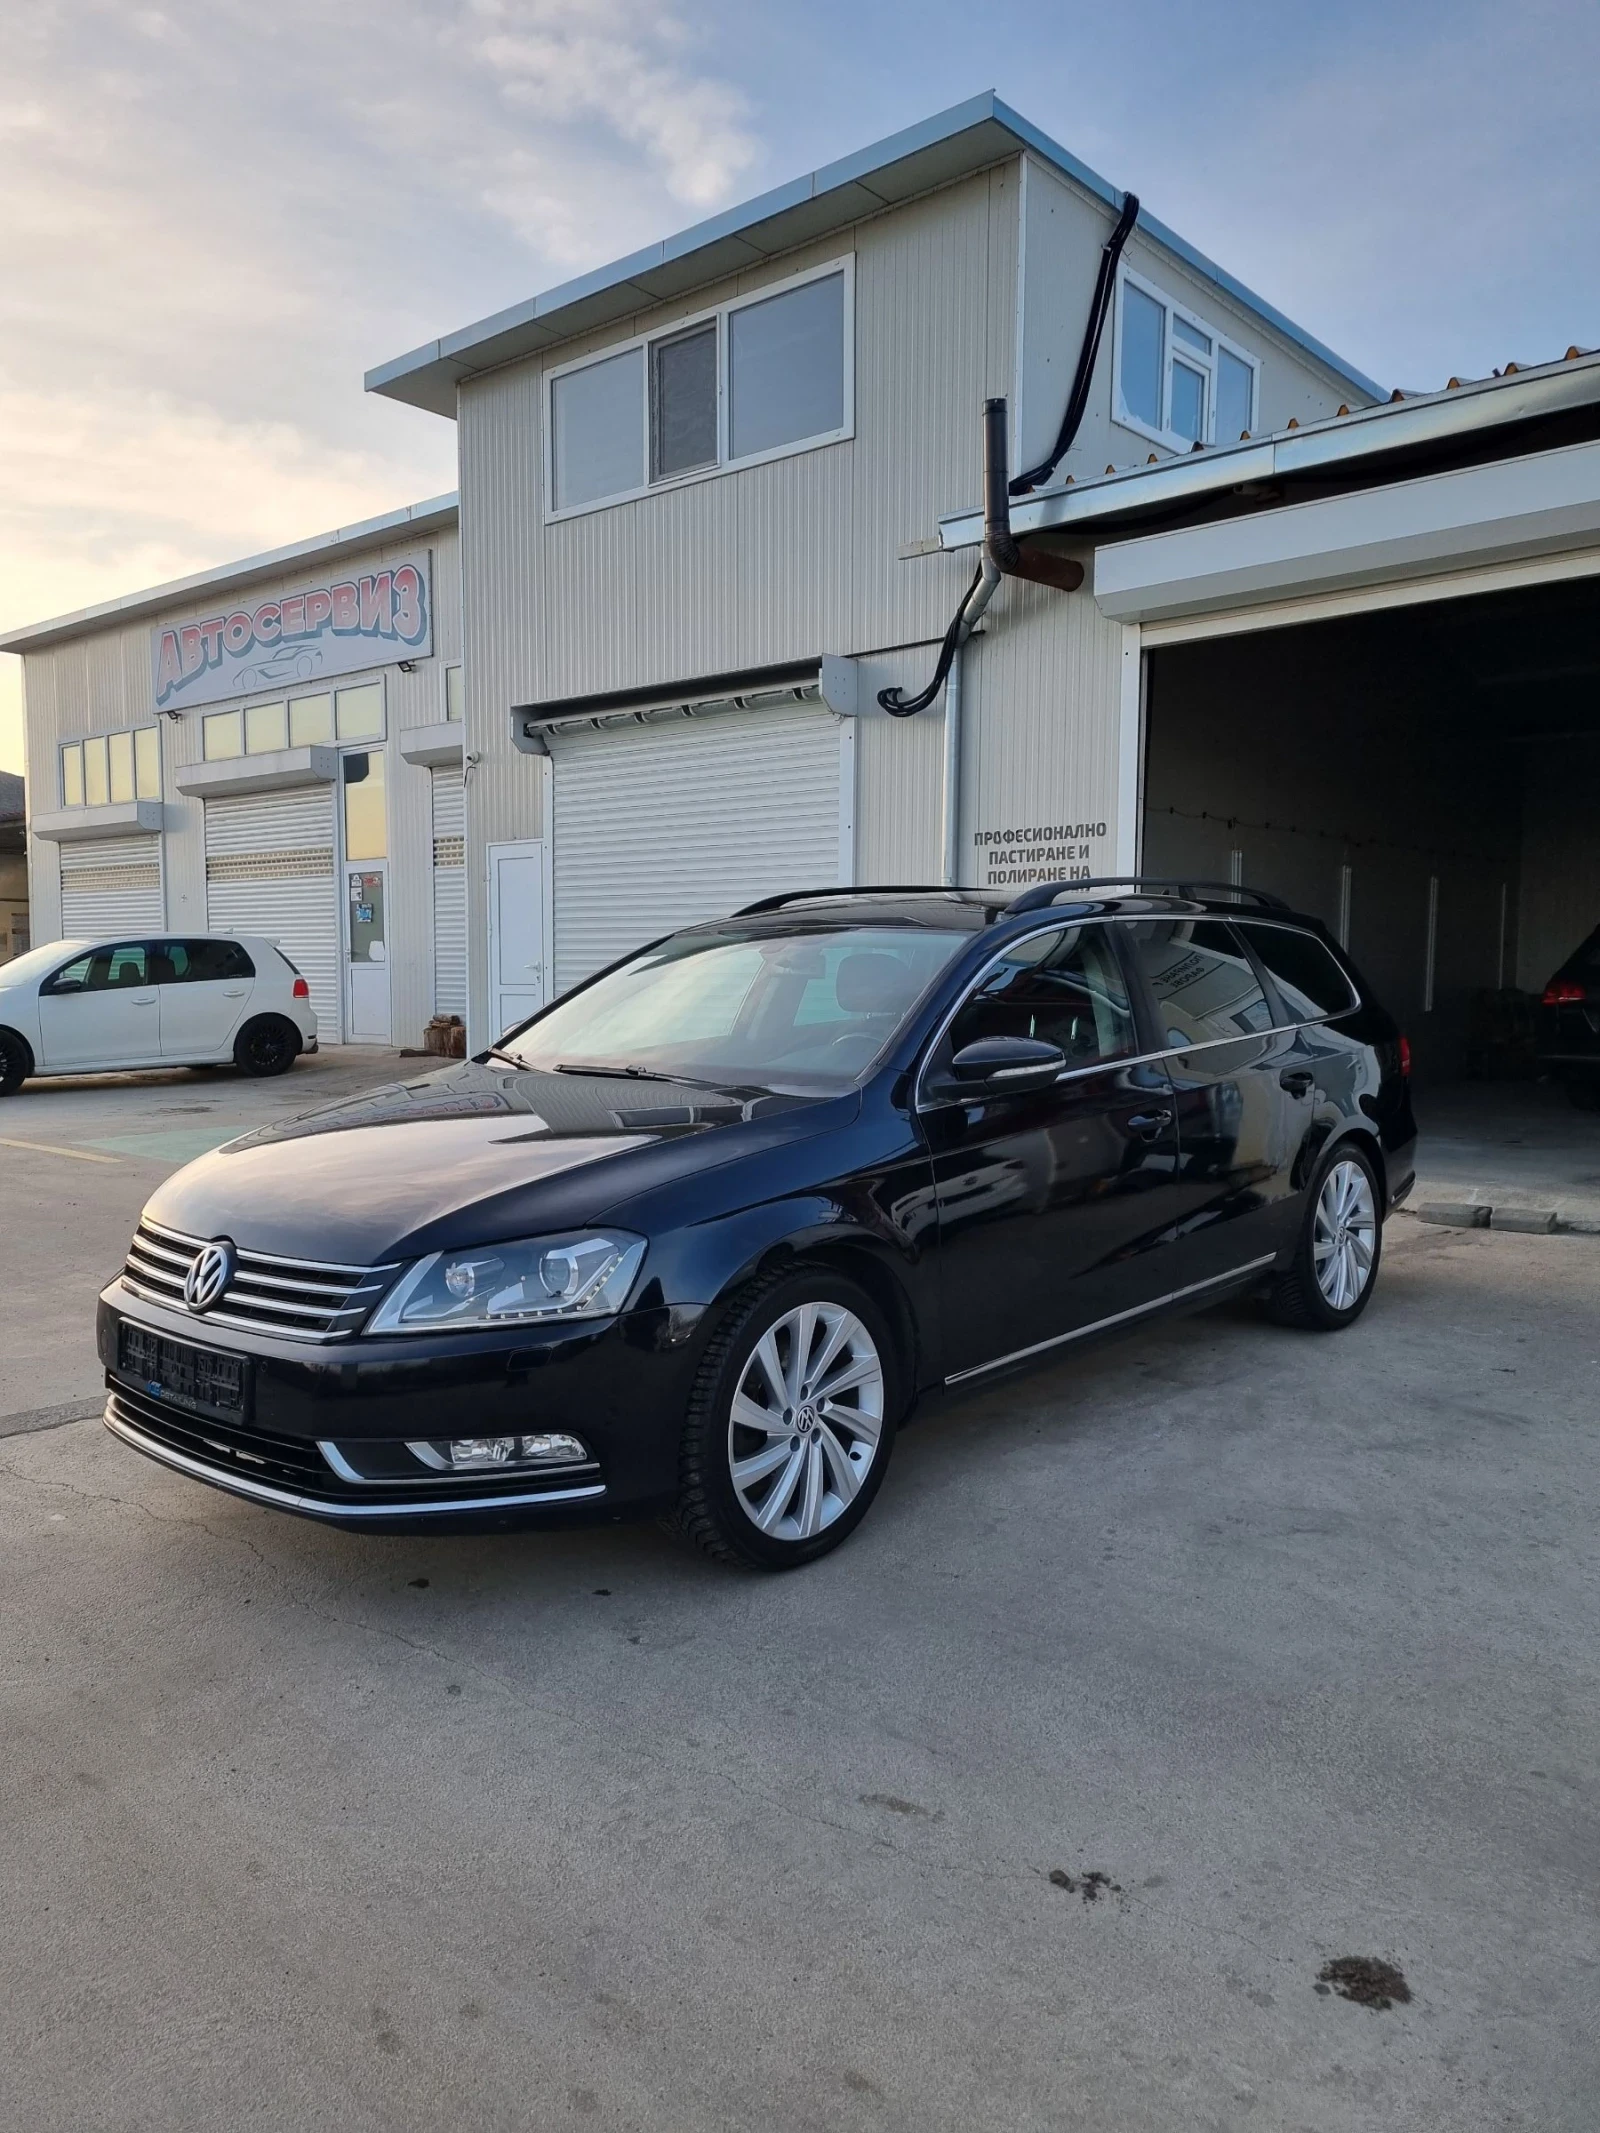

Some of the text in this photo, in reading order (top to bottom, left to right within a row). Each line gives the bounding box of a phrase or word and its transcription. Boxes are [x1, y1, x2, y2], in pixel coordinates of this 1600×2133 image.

[156, 564, 427, 706] АВТОСЕРВИЗ
[974, 822, 1107, 846] ПРОФЕСИОНАЛНО
[989, 844, 1090, 865] ПАСТИРАНЕ И
[988, 865, 1091, 885] ПОЛИРАНЕ НА
